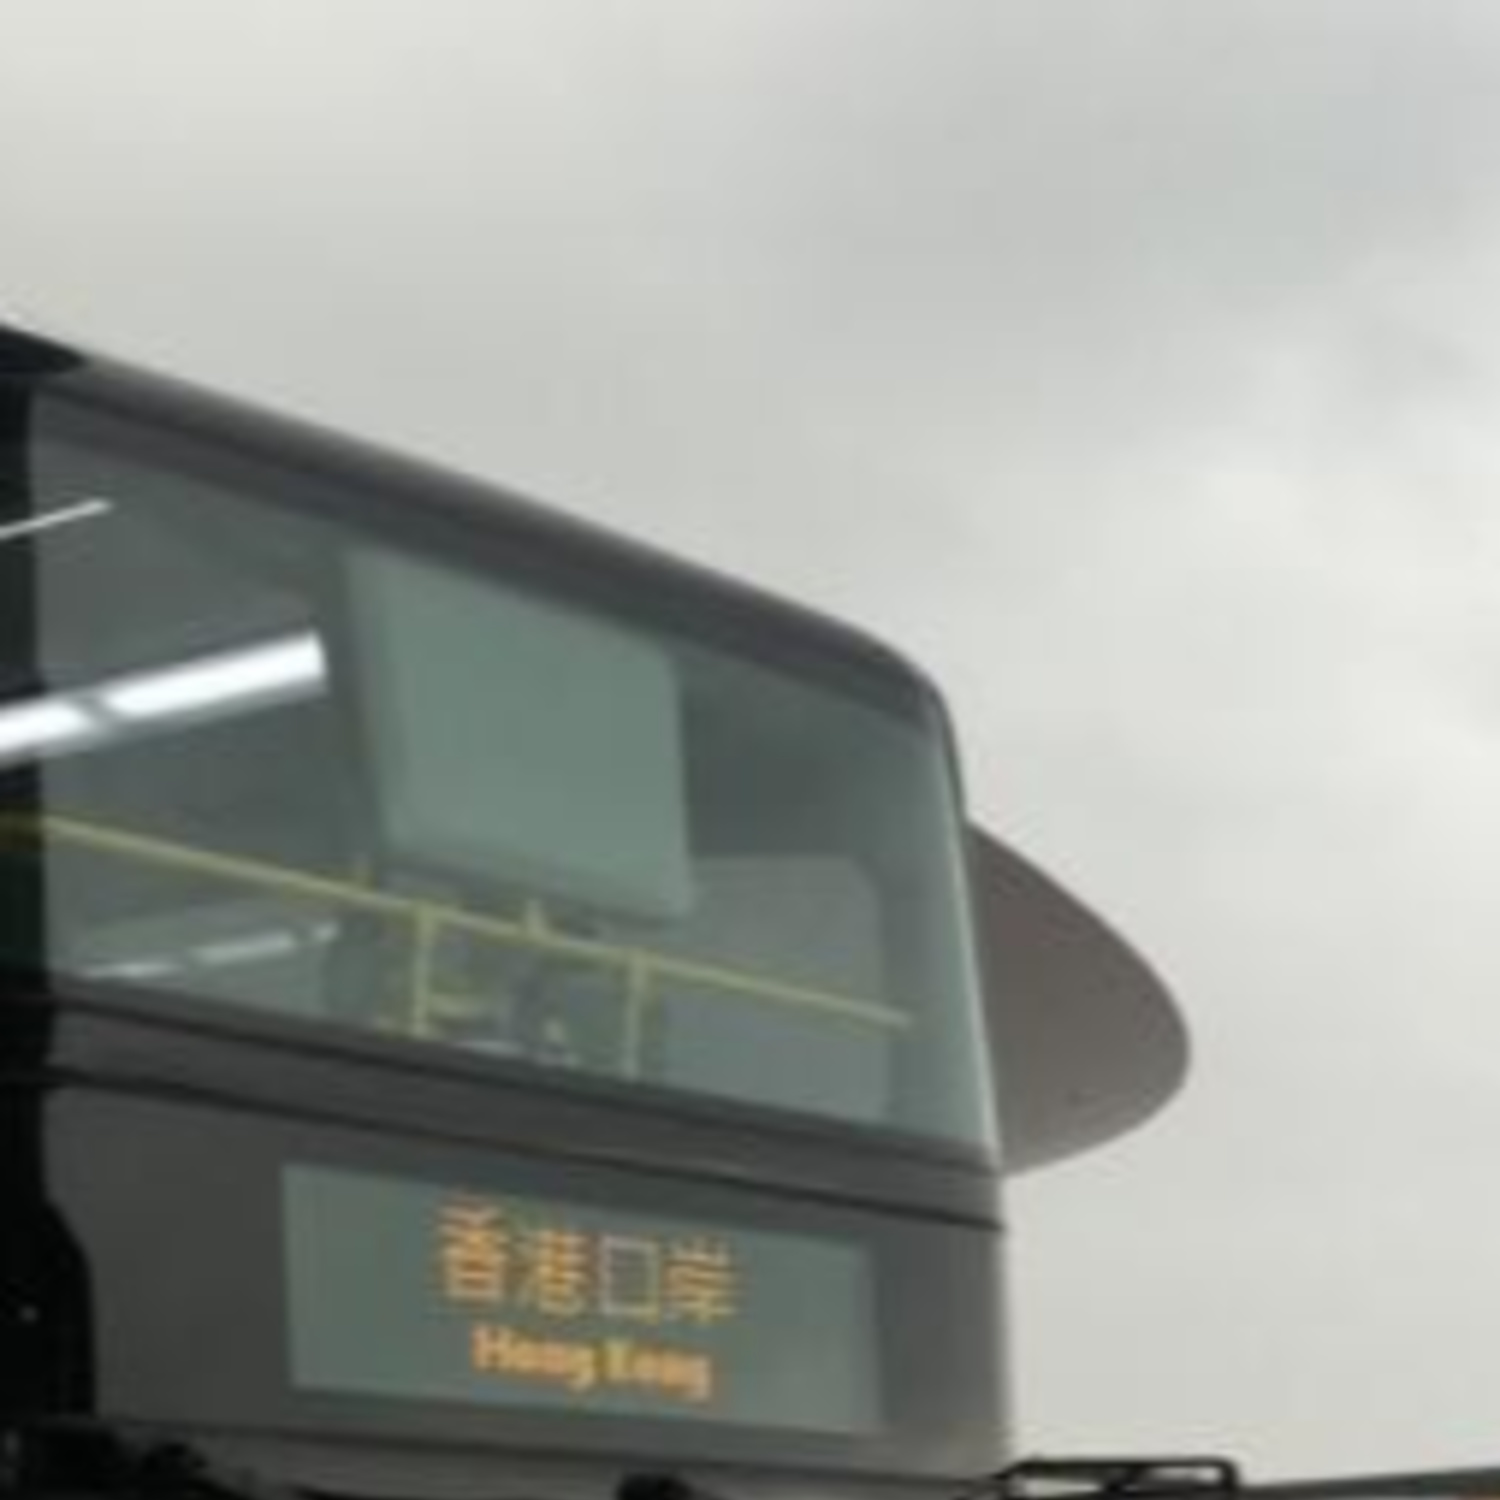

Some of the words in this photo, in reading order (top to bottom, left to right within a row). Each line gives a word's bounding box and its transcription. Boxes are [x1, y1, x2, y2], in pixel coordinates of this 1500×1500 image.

[438, 1199, 736, 1324] 香港口岸
[471, 1324, 597, 1391] Hong
[604, 1338, 712, 1401] Kong
